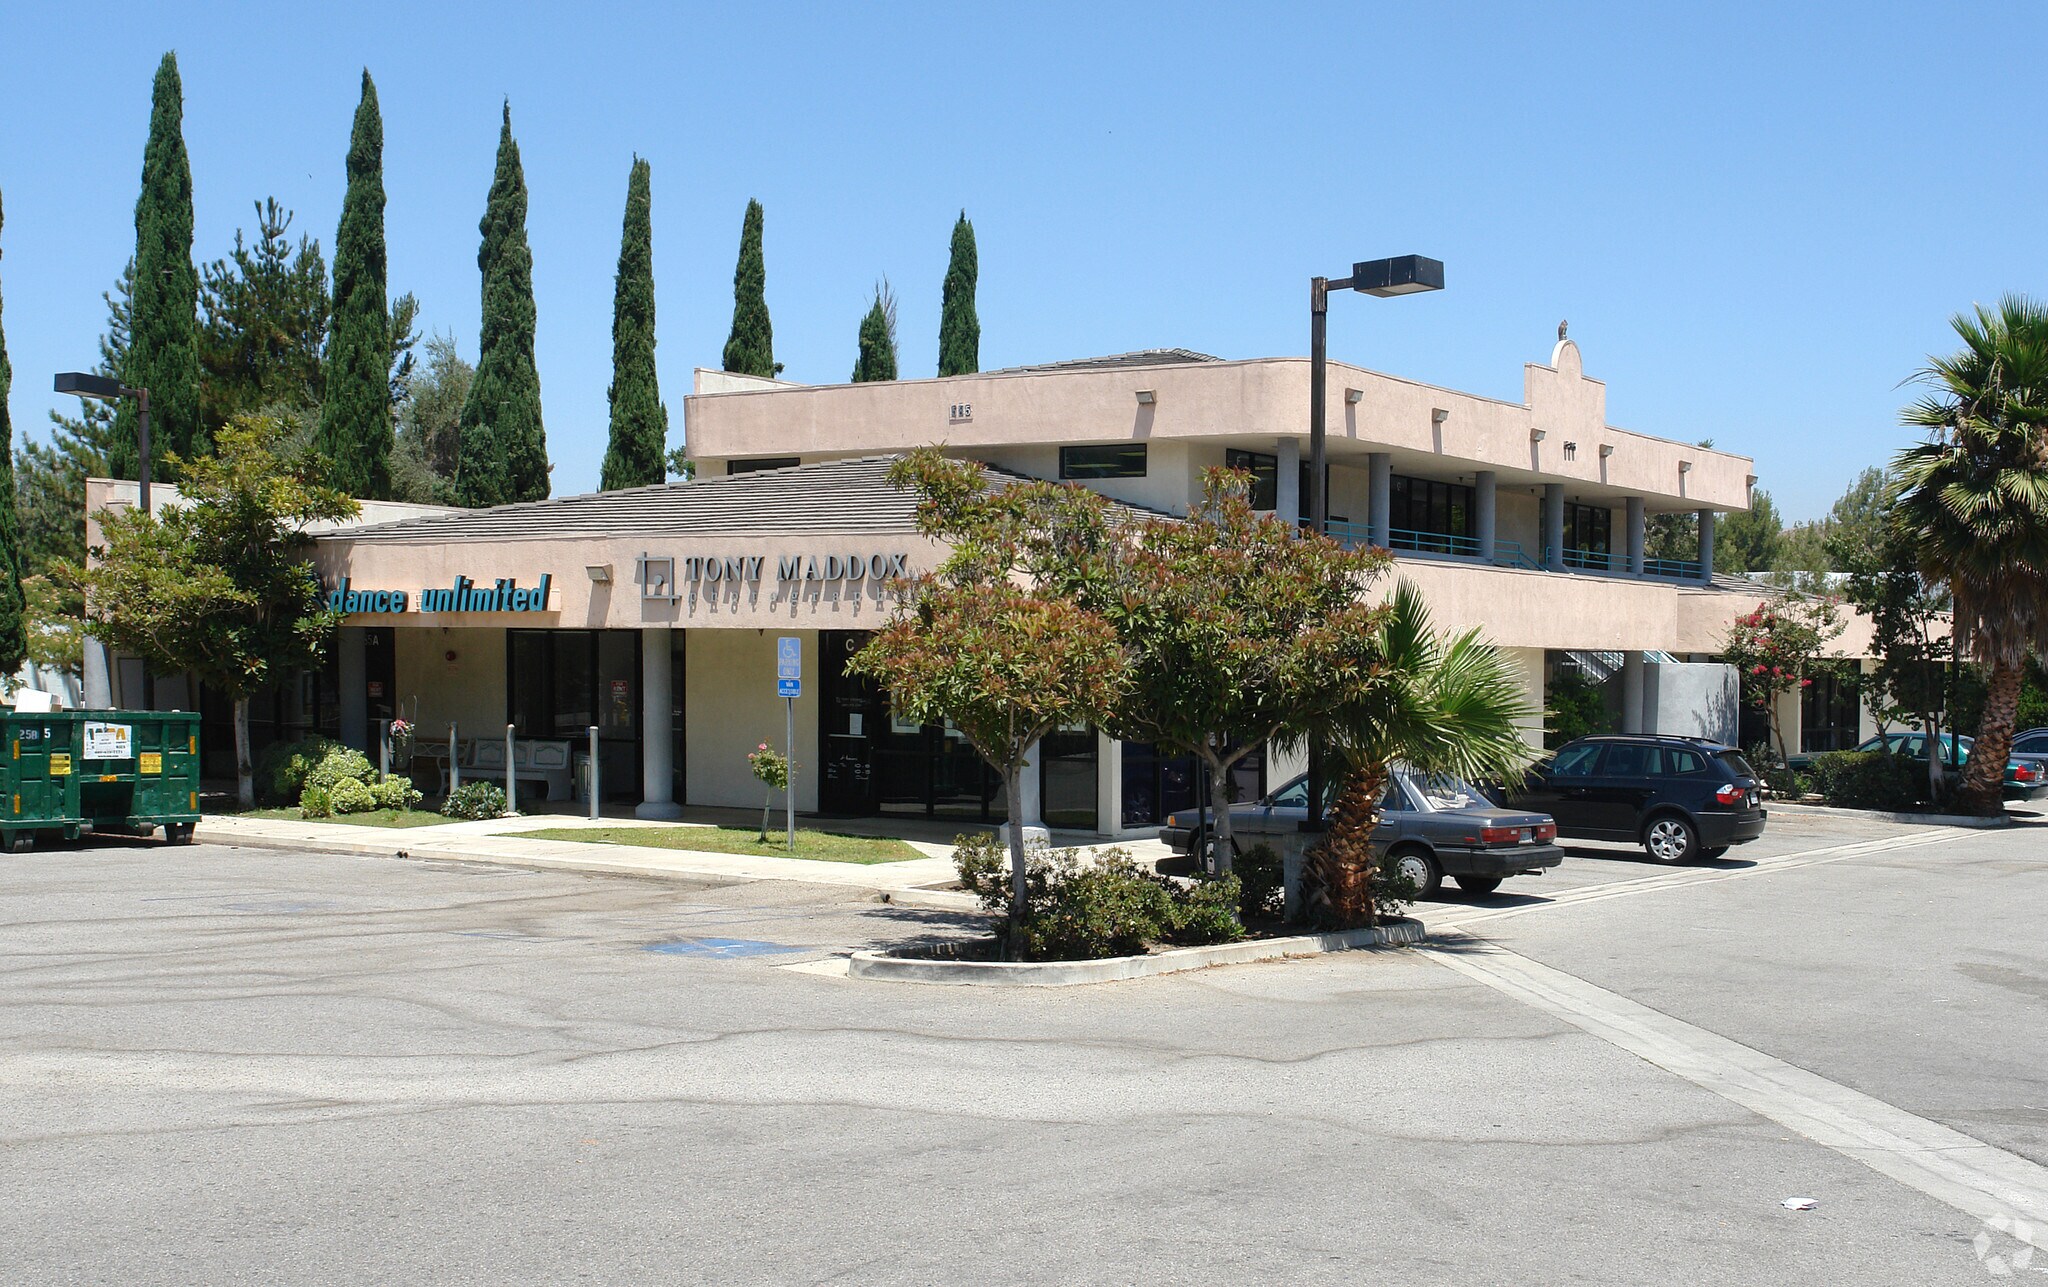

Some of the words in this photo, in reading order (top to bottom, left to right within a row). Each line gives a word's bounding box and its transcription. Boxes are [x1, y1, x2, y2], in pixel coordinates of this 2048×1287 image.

[686, 555, 765, 582] TONY
[329, 577, 407, 613] dance
[420, 573, 552, 612] unlimited
[845, 638, 855, 652] C
[44, 727, 51, 739] 5
